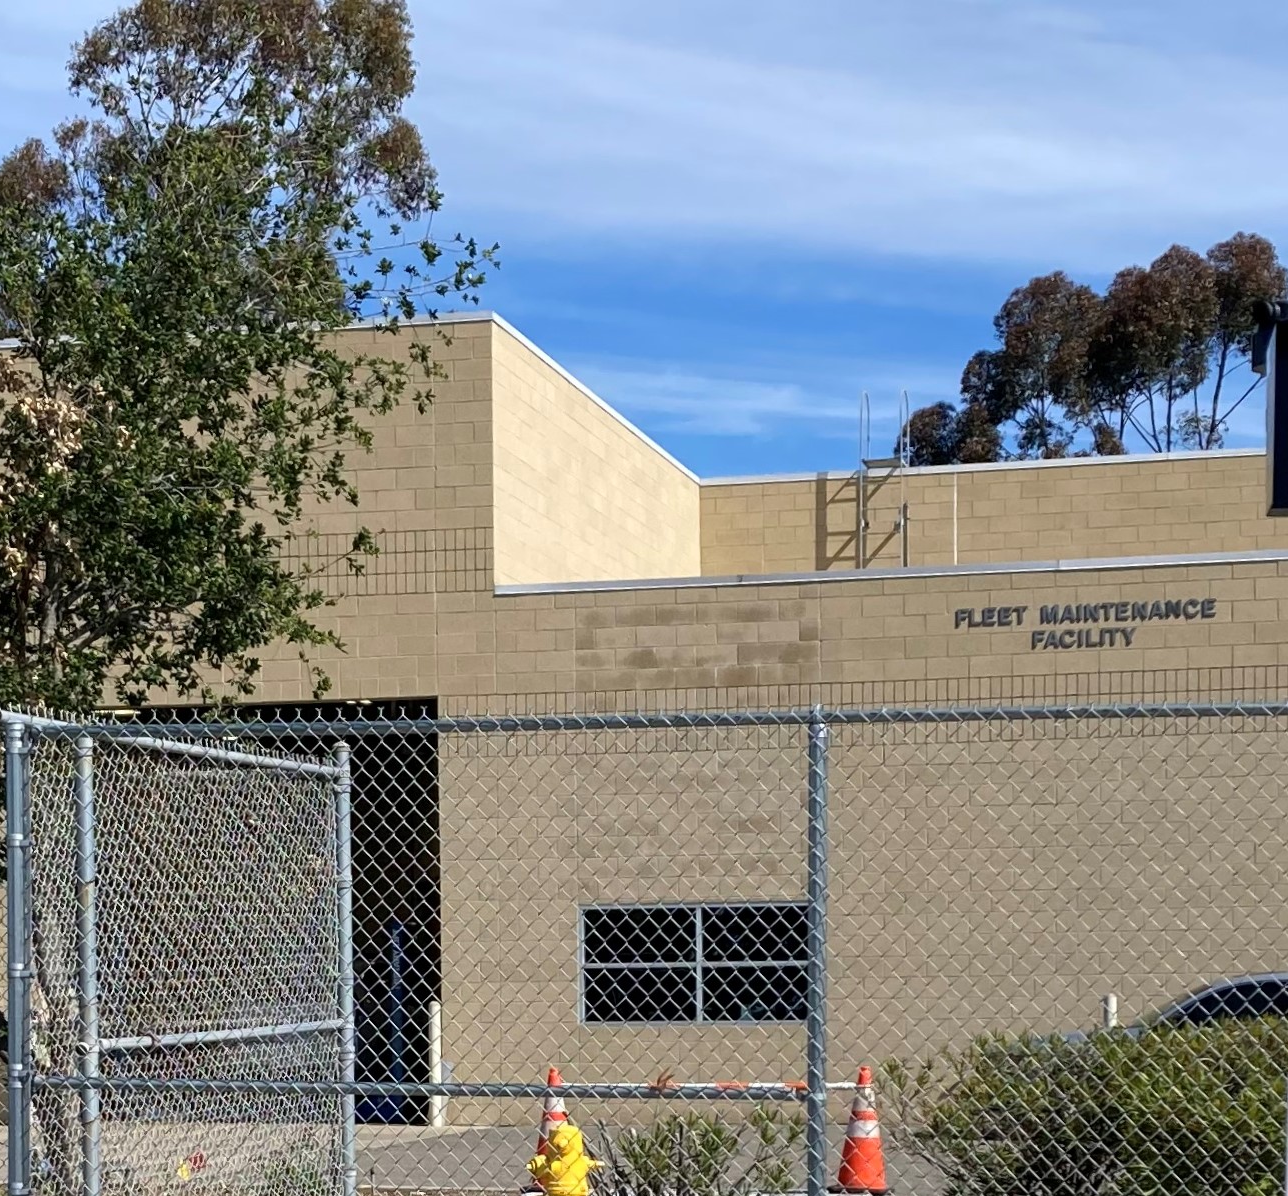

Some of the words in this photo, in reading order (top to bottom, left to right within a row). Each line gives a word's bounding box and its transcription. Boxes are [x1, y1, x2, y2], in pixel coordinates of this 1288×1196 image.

[954, 605, 1028, 629] FLEET
[1039, 598, 1217, 625] MAINTENANCE
[1031, 627, 1137, 651] FACILITY
